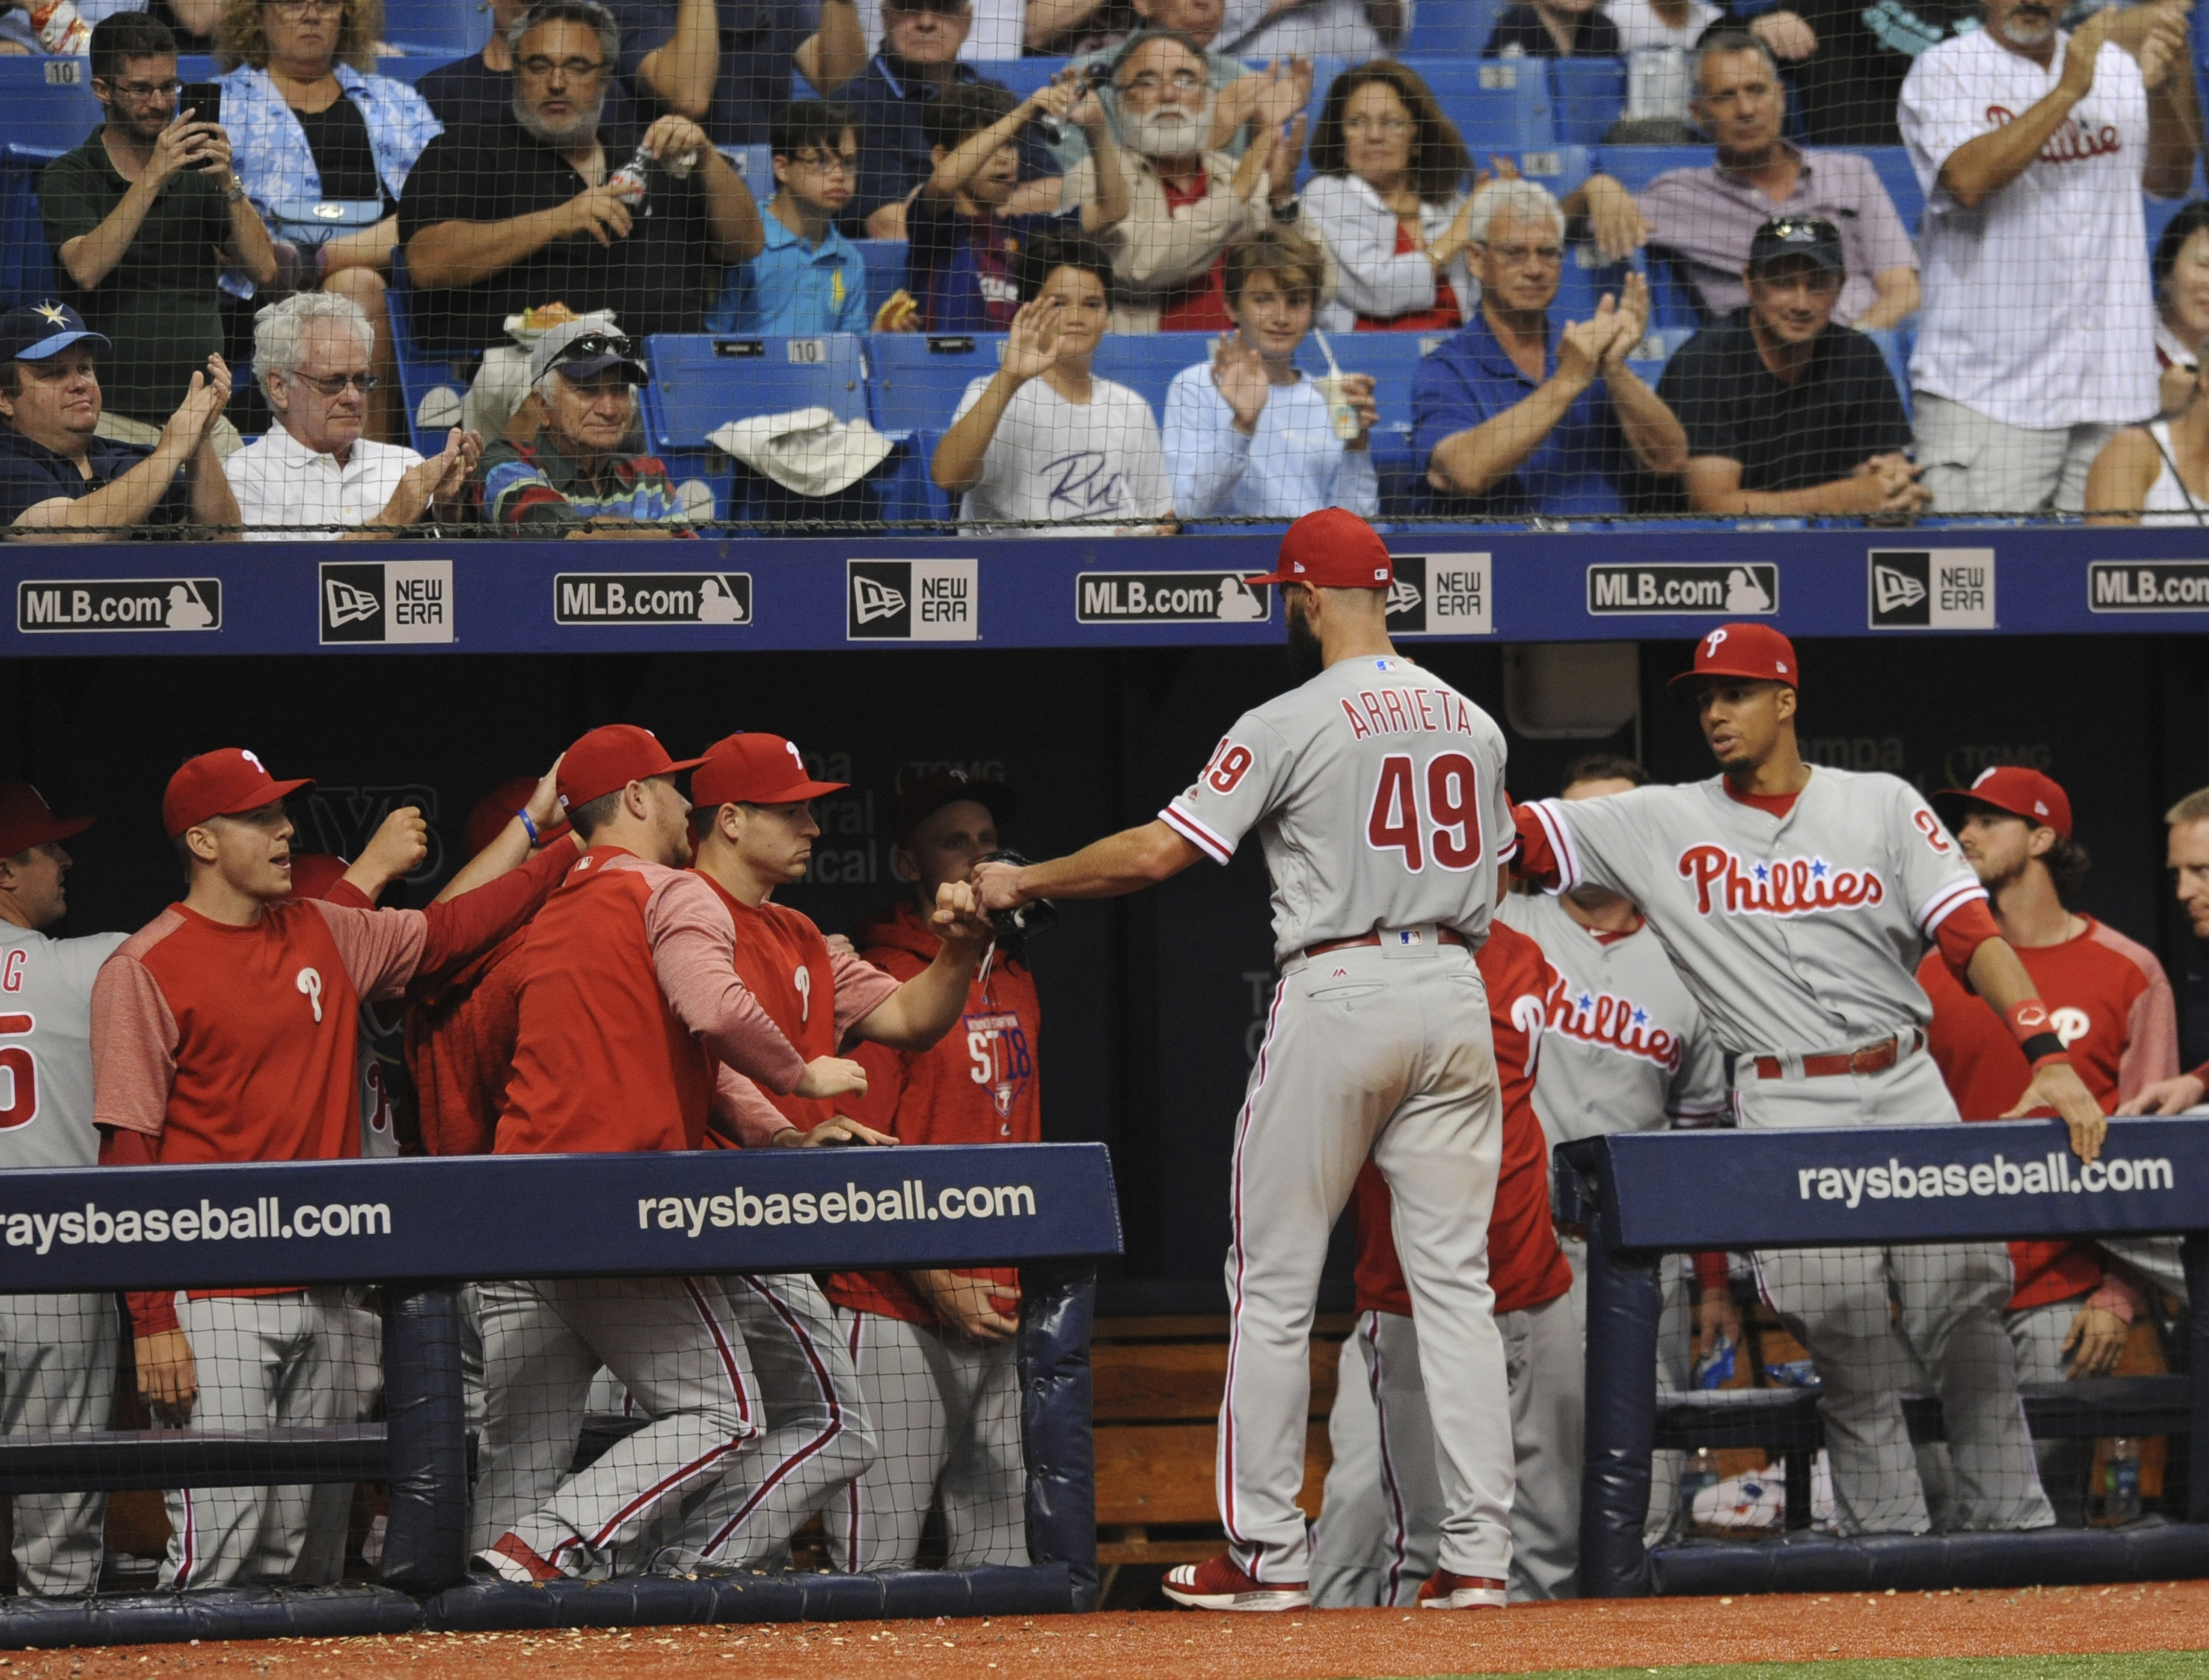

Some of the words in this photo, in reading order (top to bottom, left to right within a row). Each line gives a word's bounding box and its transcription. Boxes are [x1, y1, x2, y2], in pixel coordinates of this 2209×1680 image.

[53, 64, 73, 83] 10
[795, 341, 817, 364] 10
[396, 579, 442, 601] NEW
[922, 577, 967, 599] NEW
[1437, 572, 1480, 593] NEW
[1595, 574, 1722, 607] MLB.com
[1940, 567, 1984, 588] NEW
[27, 591, 162, 623] MLB.com
[562, 583, 694, 616] MLB.com
[922, 600, 967, 622] ERA
[1084, 582, 1212, 614] MLB.com
[1437, 594, 1480, 616] ERA
[1940, 589, 1984, 611] ERA
[396, 603, 442, 624] ERA
[1707, 629, 1728, 658] P
[1339, 686, 1474, 741] ARRIETA
[241, 749, 265, 774] P
[1365, 749, 1484, 875] 49
[1677, 840, 1888, 920] Phillies
[297, 967, 322, 1023] P
[794, 965, 810, 1023] P
[1511, 994, 1546, 1078] P
[1798, 1152, 2174, 1209] raysbaseball.com
[637, 1179, 1037, 1238] raysbaseball.com
